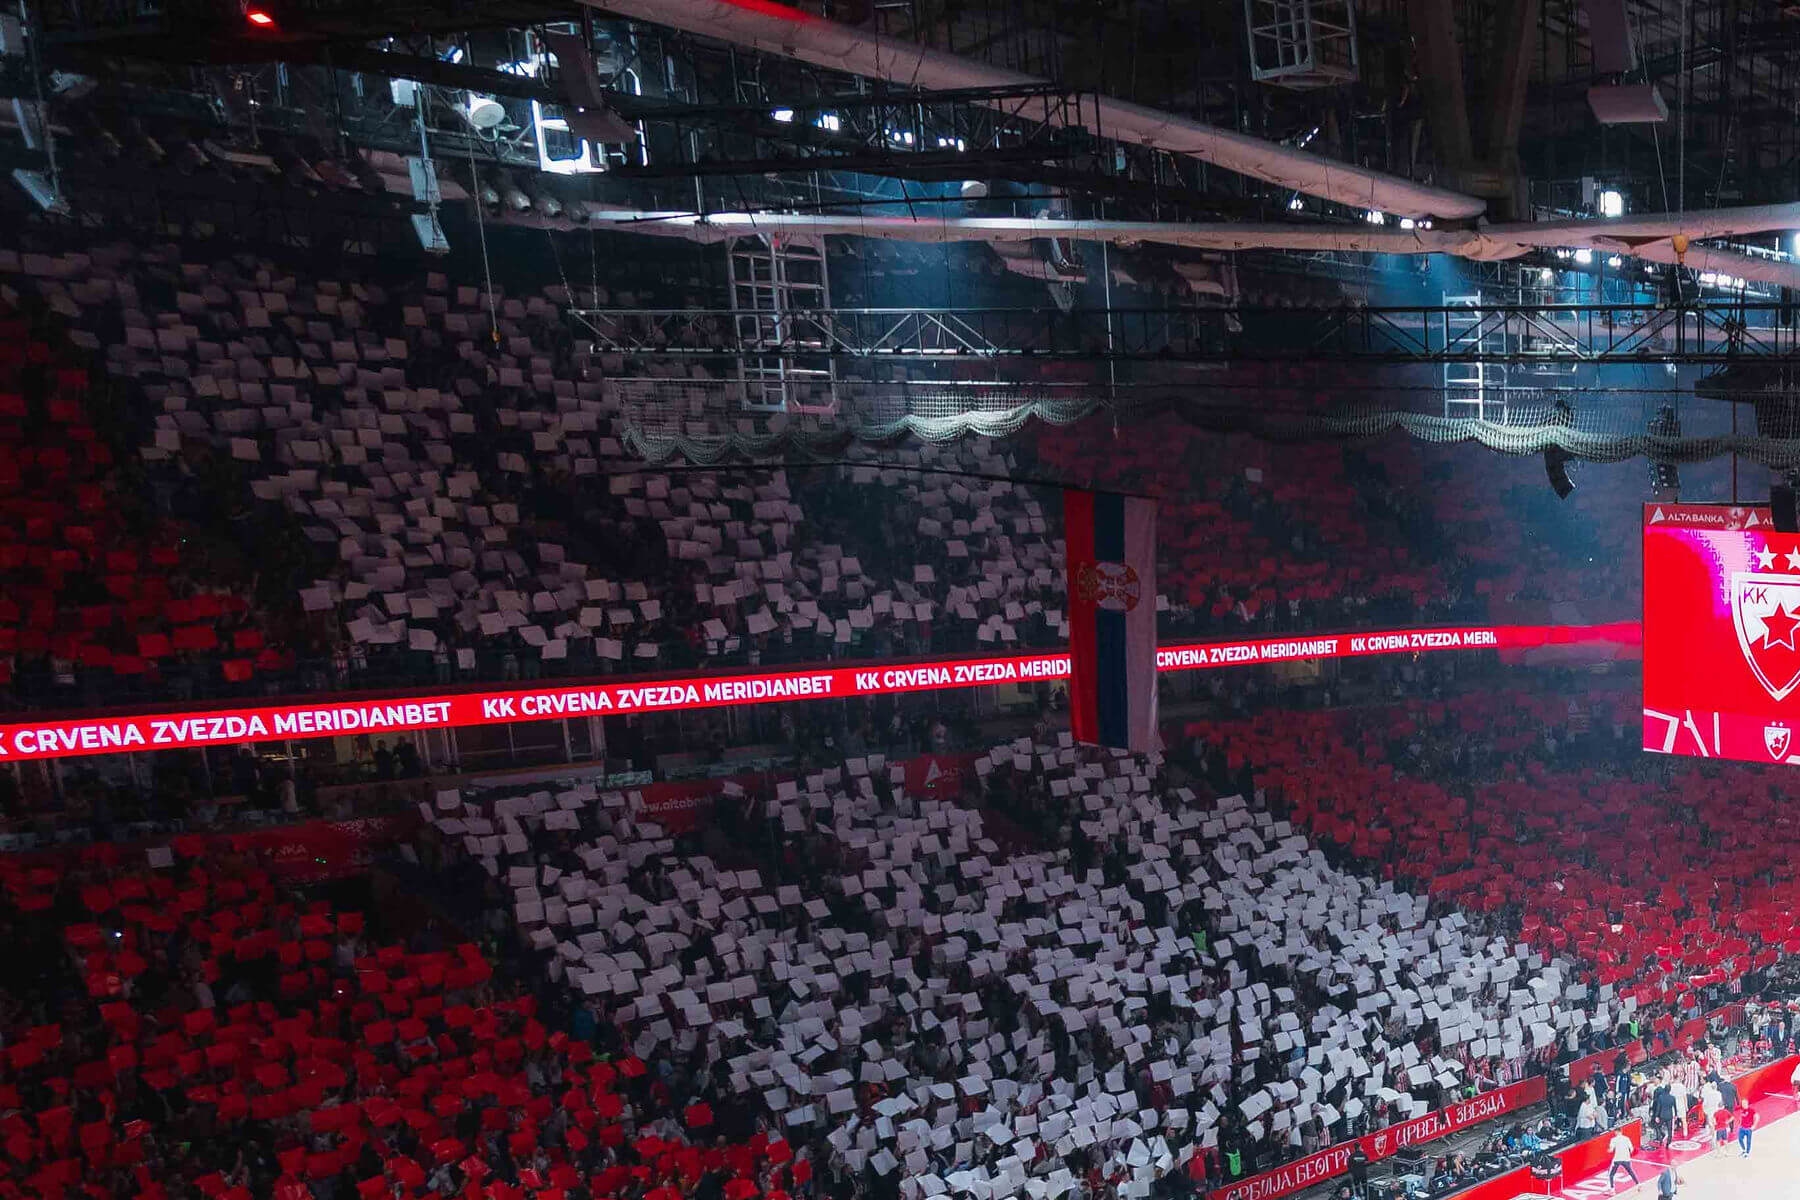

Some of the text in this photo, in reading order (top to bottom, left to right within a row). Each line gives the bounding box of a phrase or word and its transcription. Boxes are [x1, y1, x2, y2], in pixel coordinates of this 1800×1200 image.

[1667, 513, 1725, 524] ALTABANKA
[1743, 586, 1769, 605] KK
[1157, 639, 1338, 668] CRVENA ZVEZDA MERIDIANBET
[1350, 637, 1366, 652] KK
[1367, 634, 1410, 651] CRVENA
[1410, 632, 1462, 648] ZVEZDA
[855, 658, 1072, 690] KK CRVENA ZVEZDA MERIDI
[483, 675, 833, 719] KK CRVENA ZVEZDA MERIDIANBET
[15, 722, 146, 754] CRVENA
[150, 713, 269, 744] ZVEZDA
[273, 701, 451, 735] MERIDIANBET
[1455, 1092, 1506, 1125] ЗВЕЗДА
[1295, 1147, 1352, 1186] БЕОГРА
